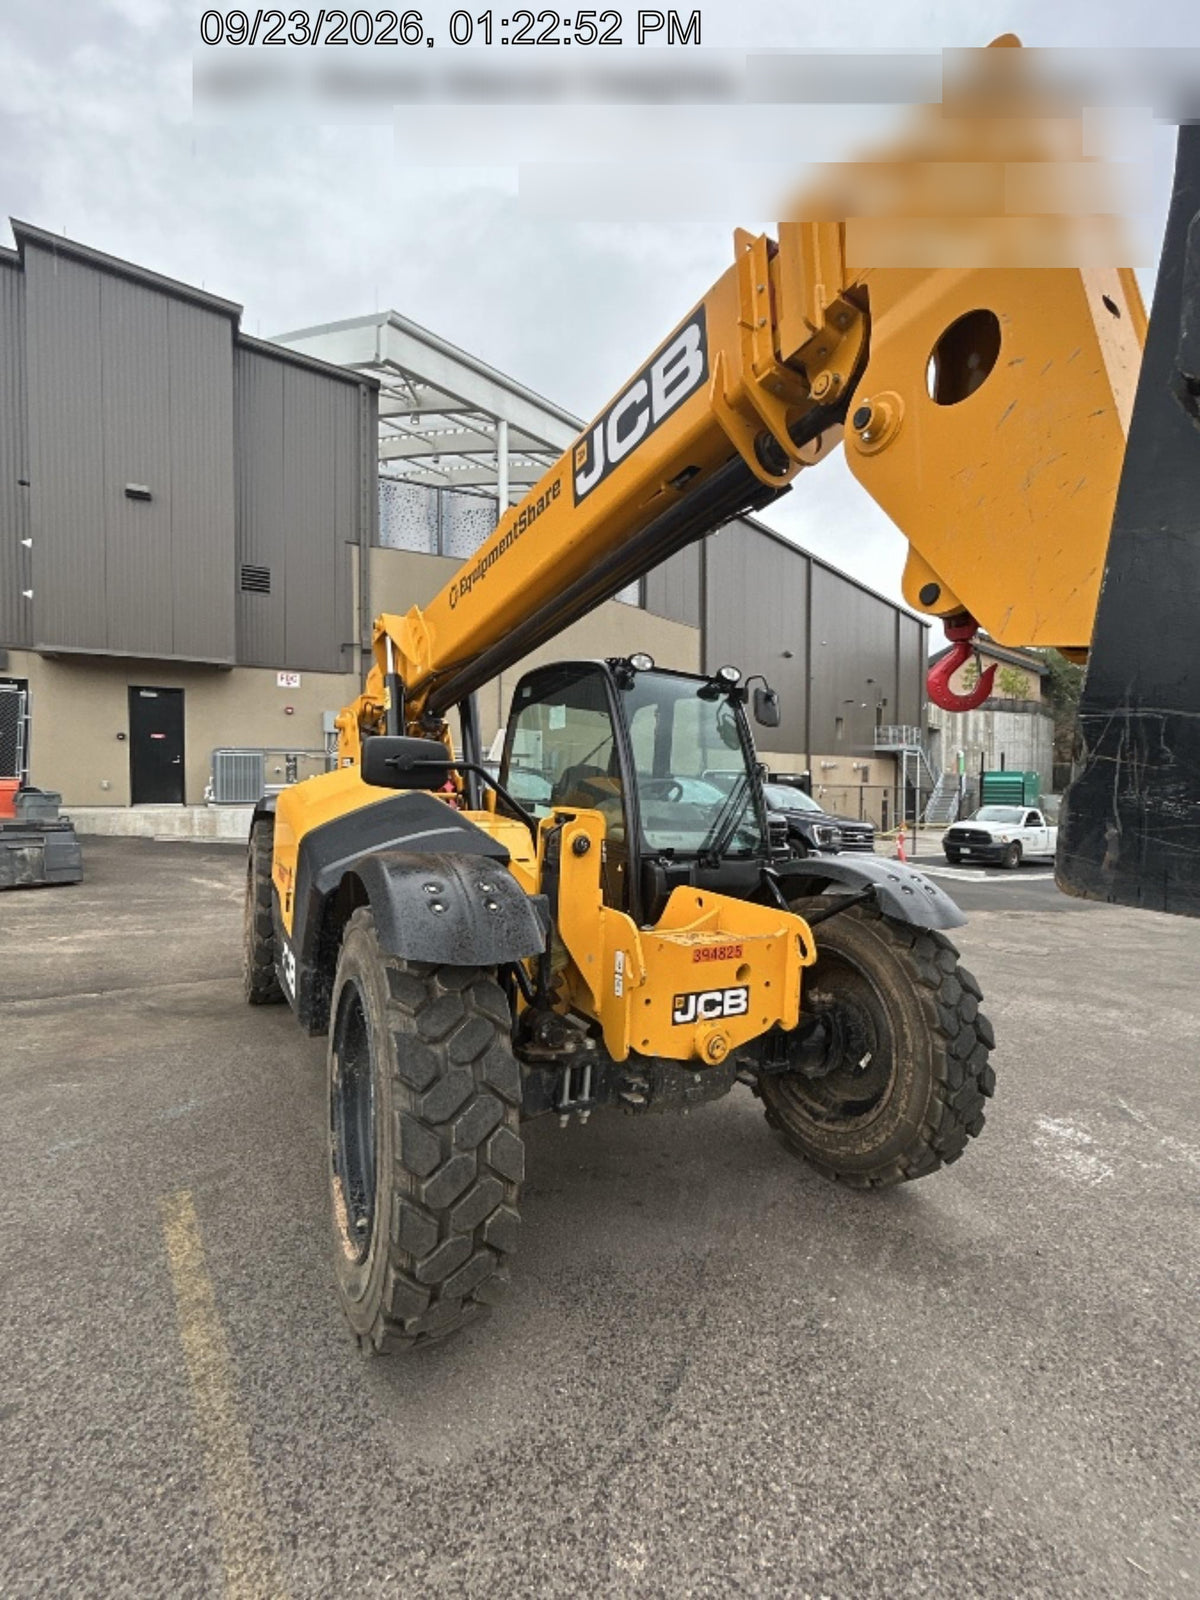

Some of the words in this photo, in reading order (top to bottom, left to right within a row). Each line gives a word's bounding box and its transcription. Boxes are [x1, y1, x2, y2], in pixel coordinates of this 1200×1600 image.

[576, 323, 703, 496] JCB
[460, 478, 561, 597] EquipmentShare
[693, 944, 743, 963] 394825
[673, 987, 749, 1023] JCB
